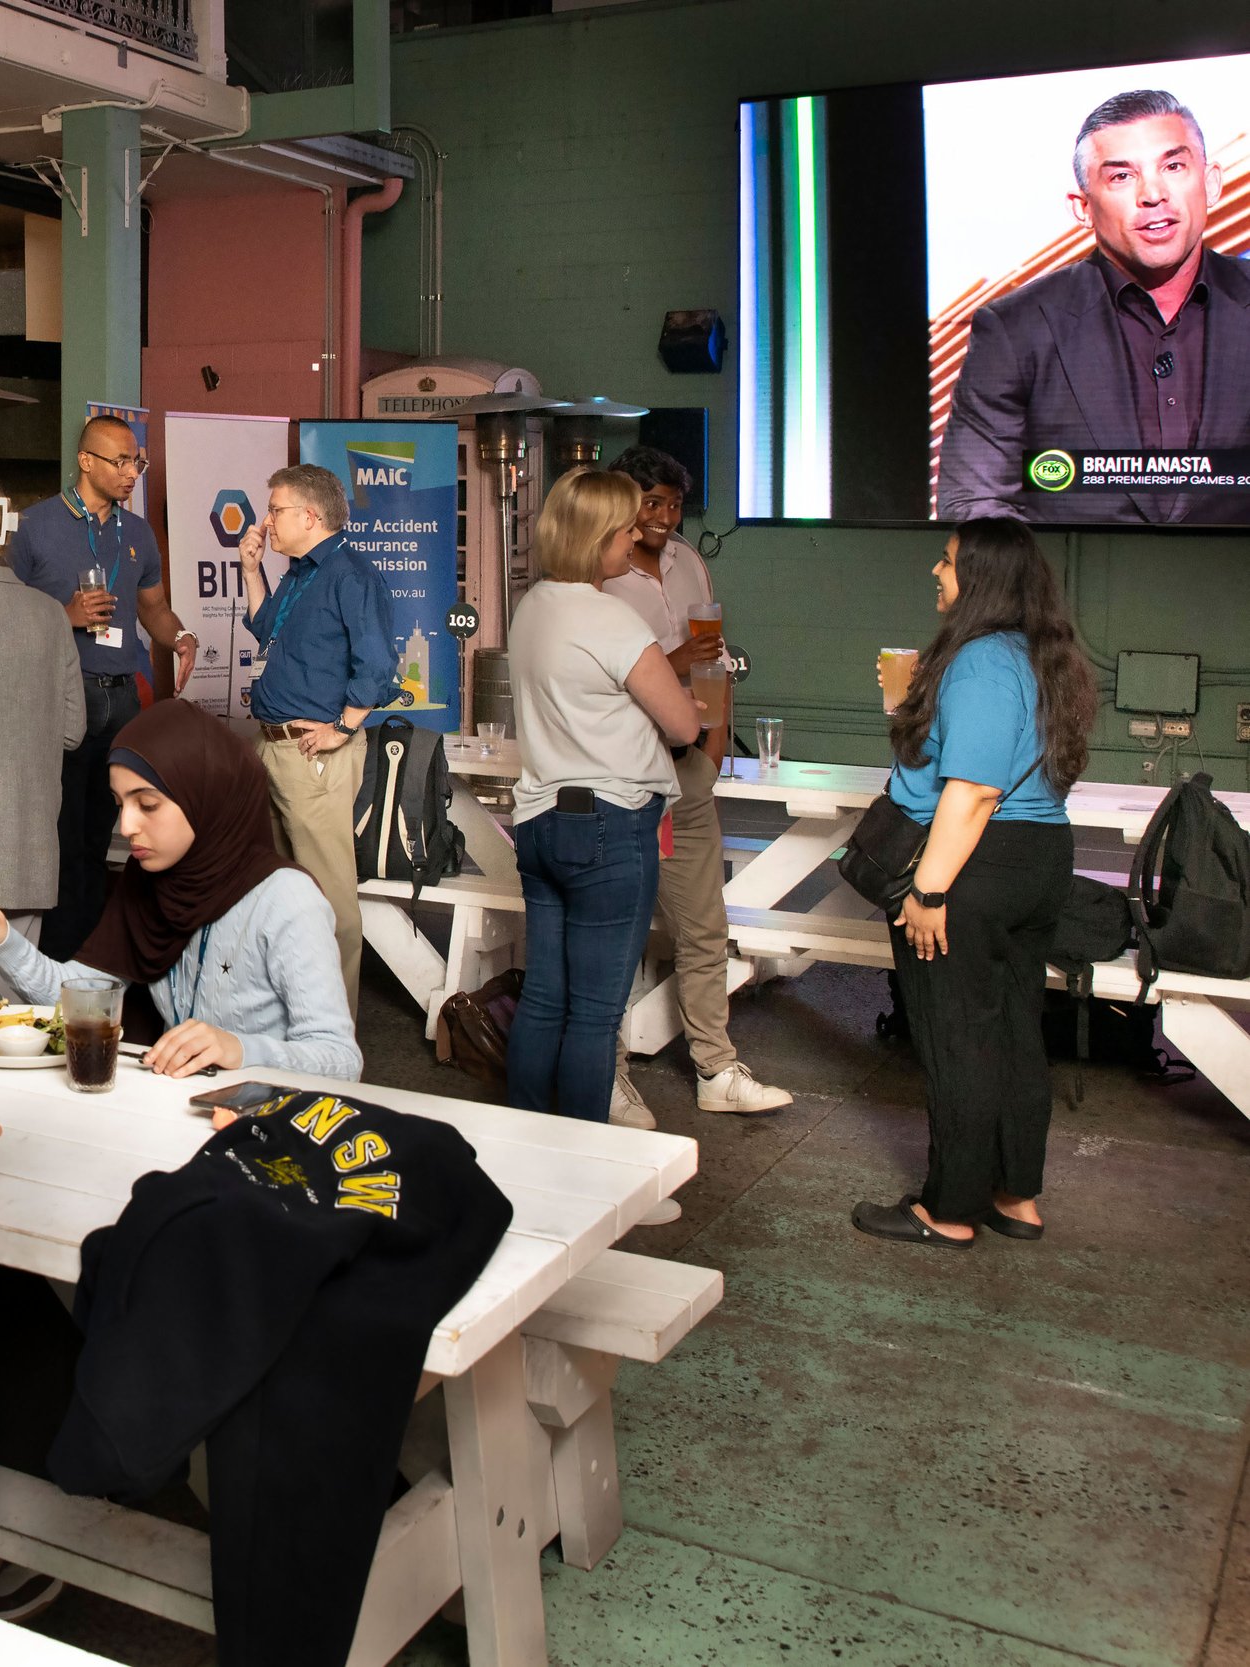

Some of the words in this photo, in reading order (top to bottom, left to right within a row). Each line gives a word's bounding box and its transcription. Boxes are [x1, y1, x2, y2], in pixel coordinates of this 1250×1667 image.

[382, 398, 469, 412] TELEPHO
[1042, 465, 1061, 474] FOX
[1083, 457, 1143, 473] BRAITH
[1146, 457, 1212, 473] ANASTA
[1082, 475, 1105, 485] 288
[1108, 475, 1188, 485] PREMIERSHIP
[1190, 475, 1235, 485] GAMES
[344, 520, 369, 533] tor
[372, 519, 439, 533] Accident
[350, 541, 418, 552] nsurance
[372, 557, 427, 571] ission
[449, 614, 476, 628] 103
[731, 657, 748, 671] 01
